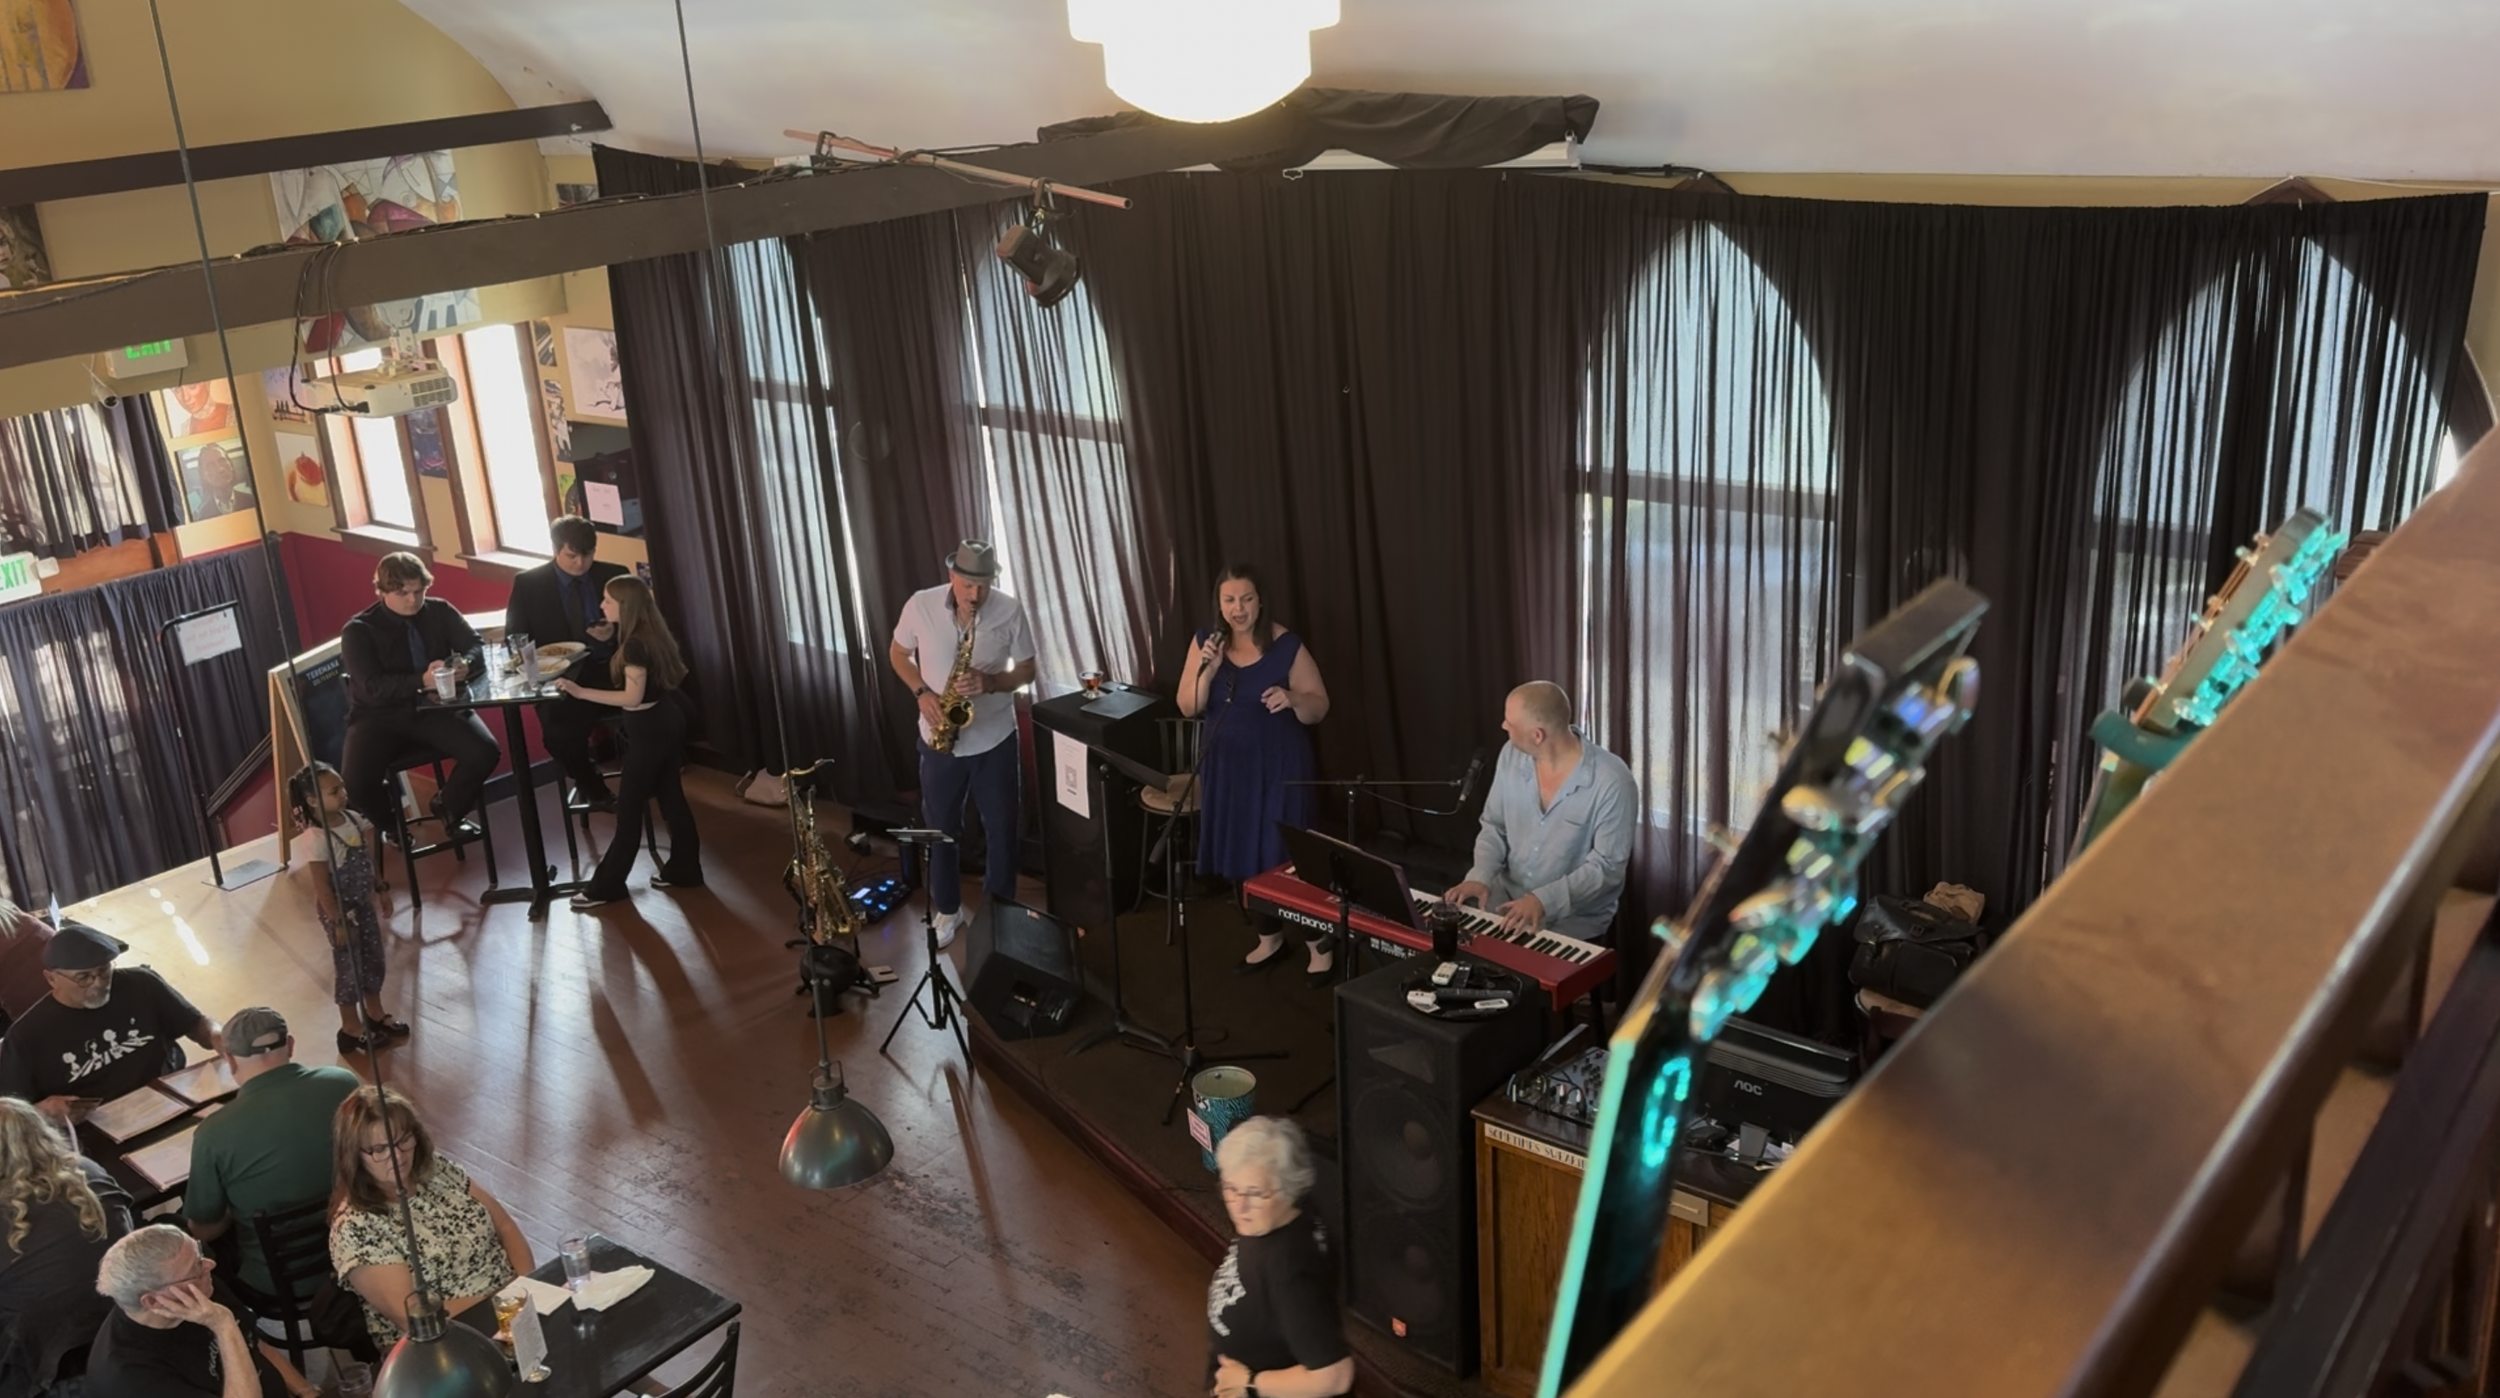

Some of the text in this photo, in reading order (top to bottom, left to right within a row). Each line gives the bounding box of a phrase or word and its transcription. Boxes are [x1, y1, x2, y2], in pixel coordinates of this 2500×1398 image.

[0, 559, 28, 590] XIT
[1278, 908, 1334, 933] nord piano 5
[1733, 1079, 1763, 1096] AOC
